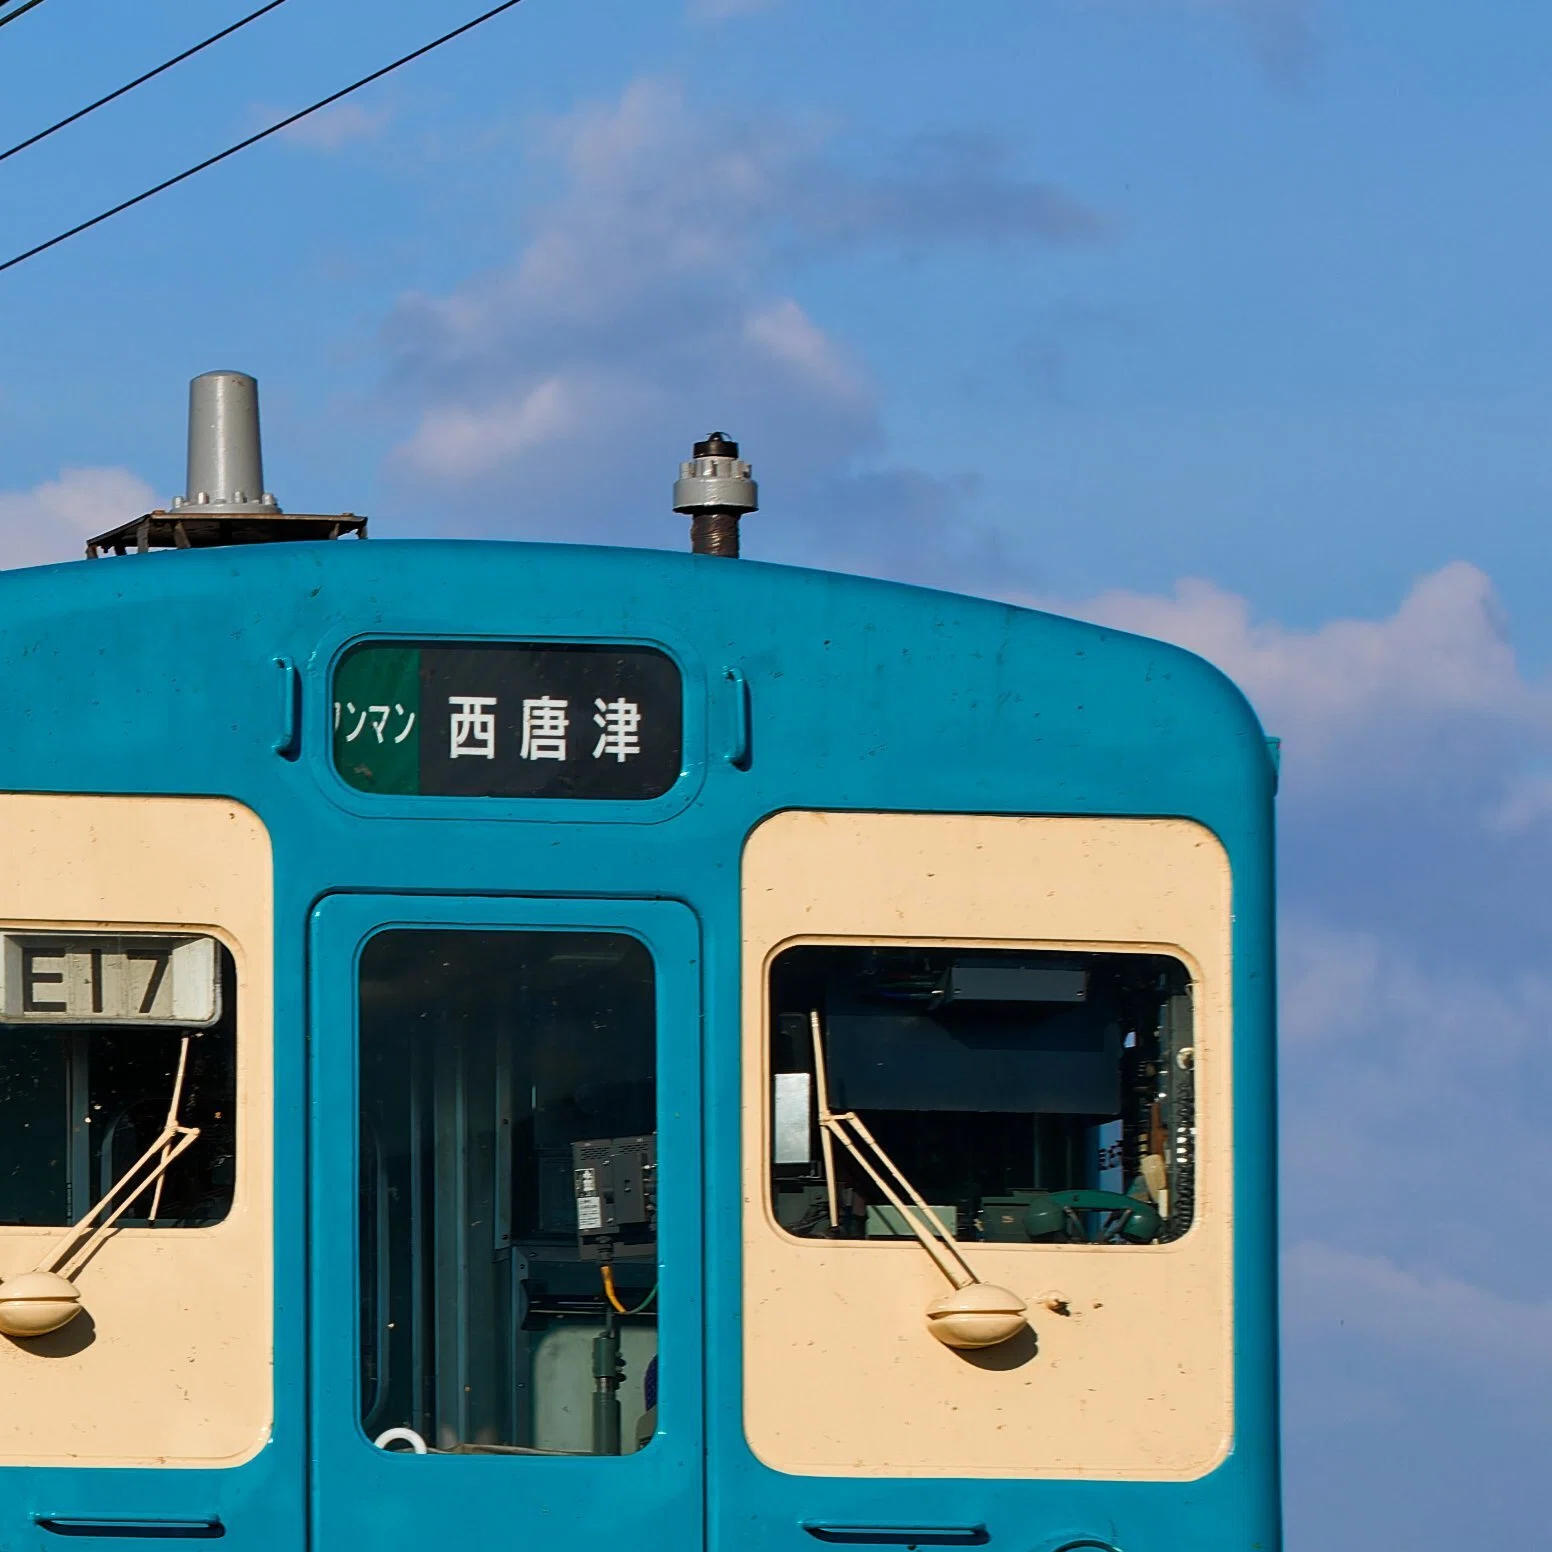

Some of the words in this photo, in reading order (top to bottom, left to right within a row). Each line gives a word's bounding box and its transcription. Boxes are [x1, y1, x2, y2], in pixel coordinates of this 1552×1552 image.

[448, 695, 642, 763] 西唐津
[22, 946, 172, 1014] E17
